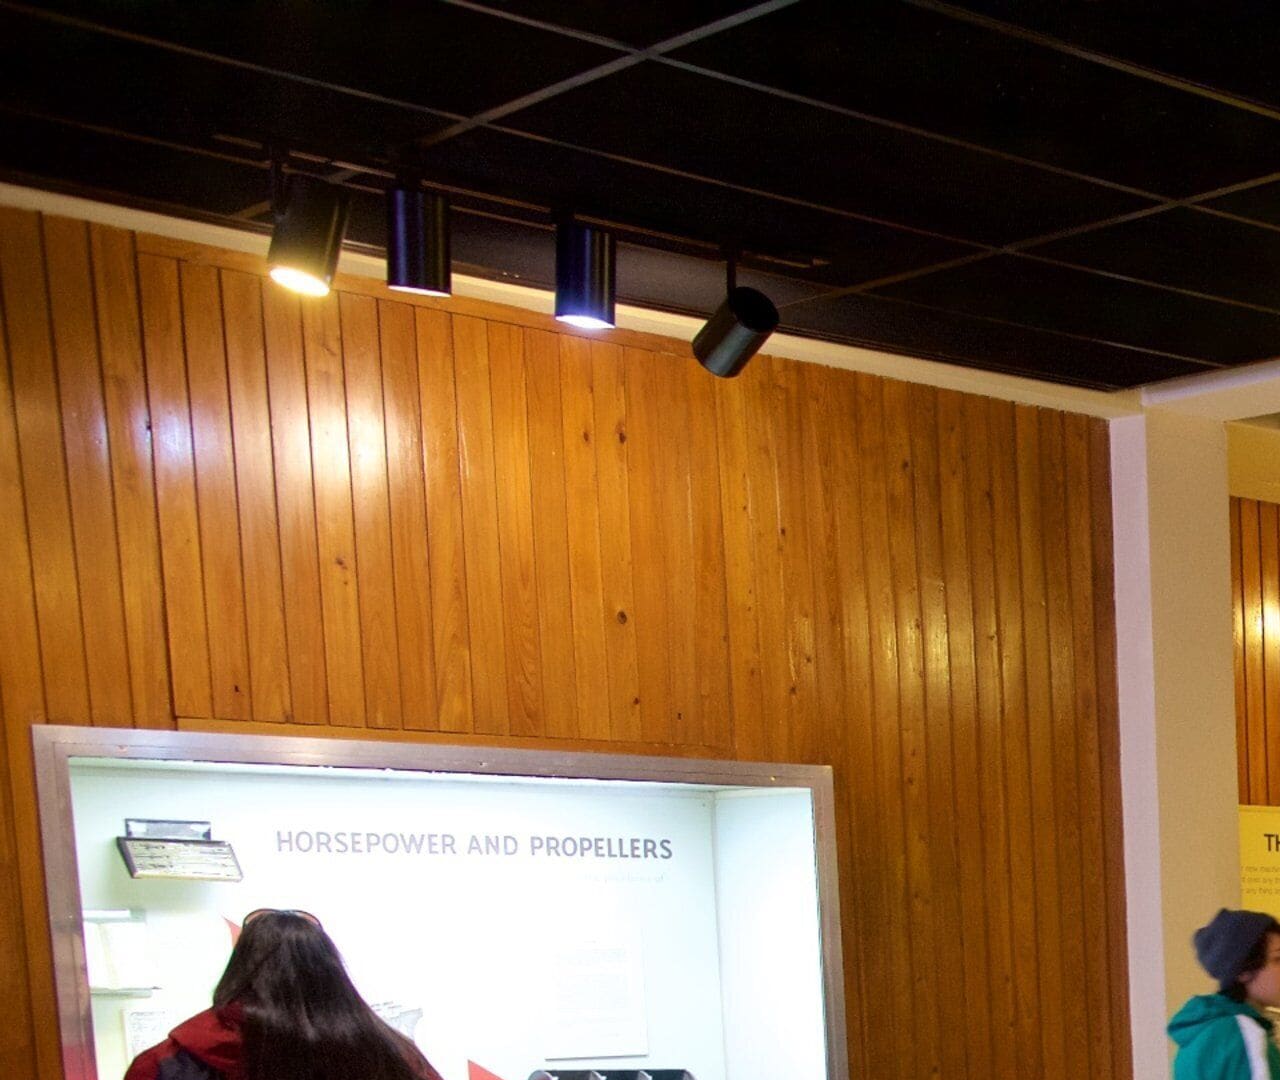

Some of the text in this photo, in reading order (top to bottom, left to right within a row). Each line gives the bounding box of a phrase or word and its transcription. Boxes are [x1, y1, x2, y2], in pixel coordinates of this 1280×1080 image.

[276, 830, 673, 860] HORSEPOWER AND PROPELLERS
